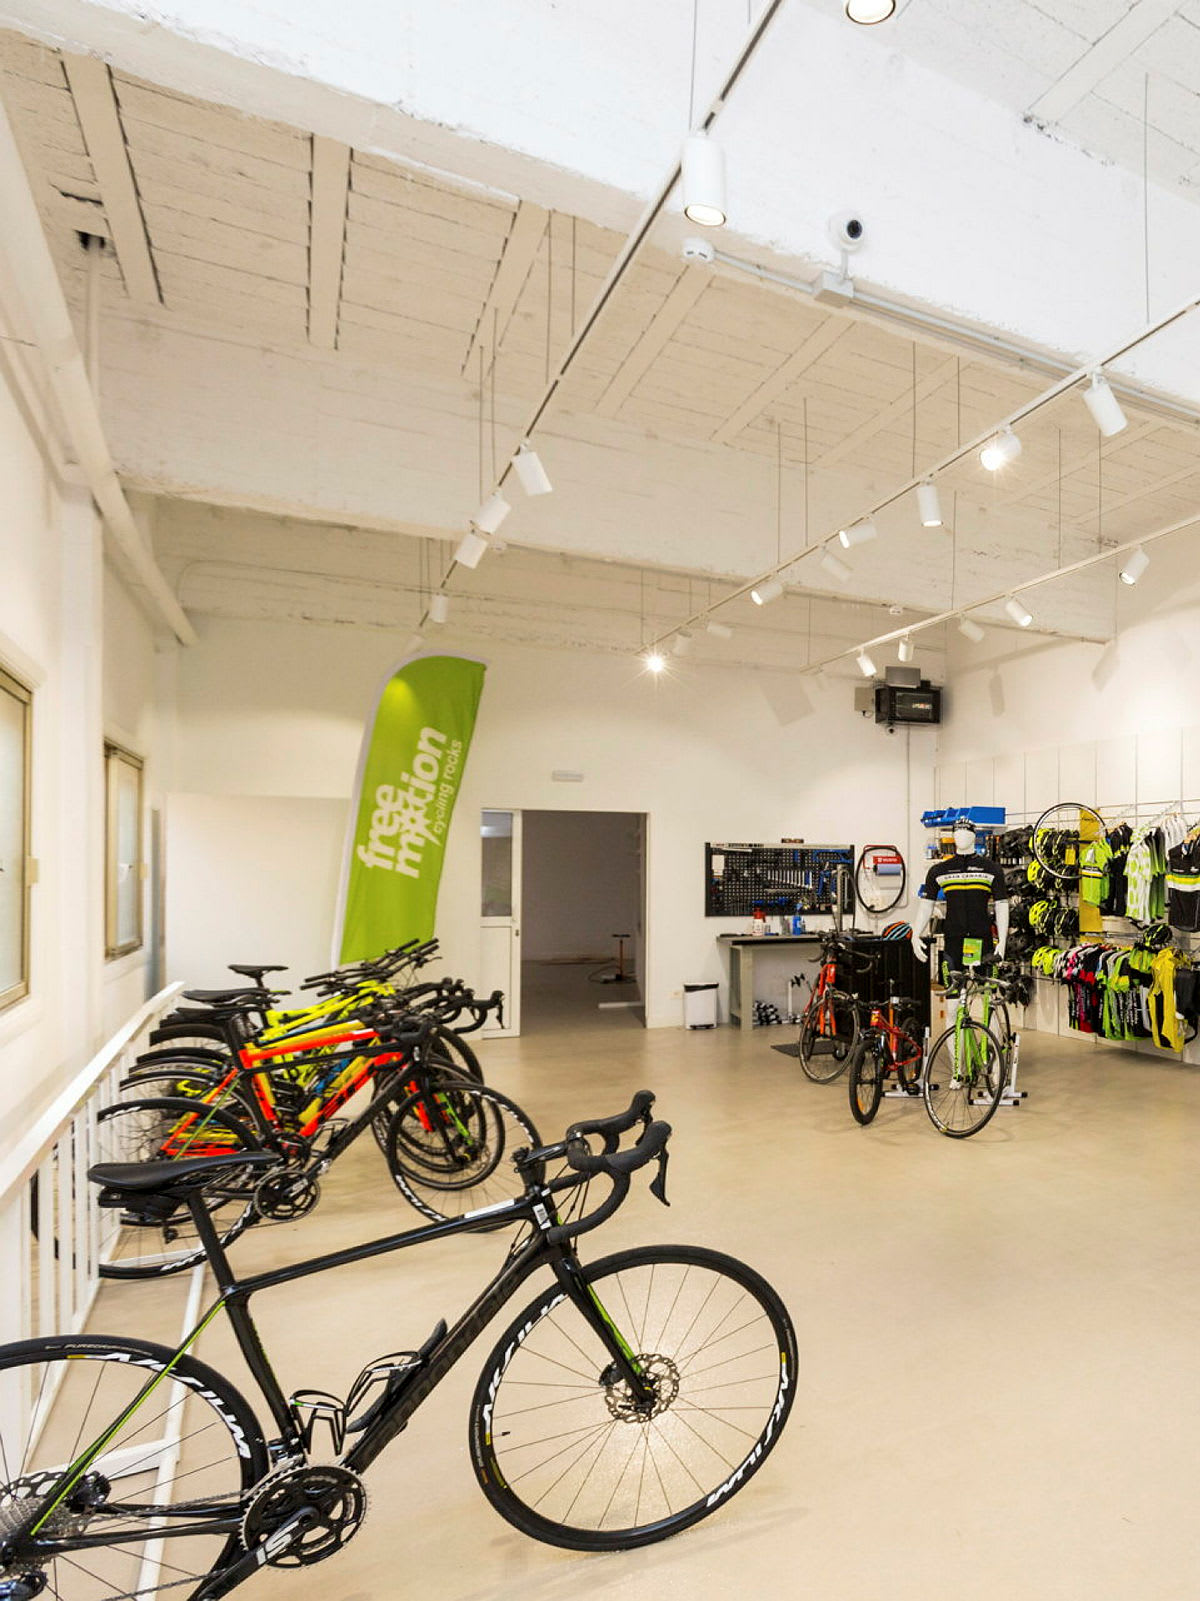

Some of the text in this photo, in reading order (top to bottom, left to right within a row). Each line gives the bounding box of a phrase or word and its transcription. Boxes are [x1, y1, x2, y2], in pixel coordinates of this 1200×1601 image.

[357, 784, 401, 871] free
[394, 726, 447, 879] motion
[433, 739, 462, 835] cycling rocks
